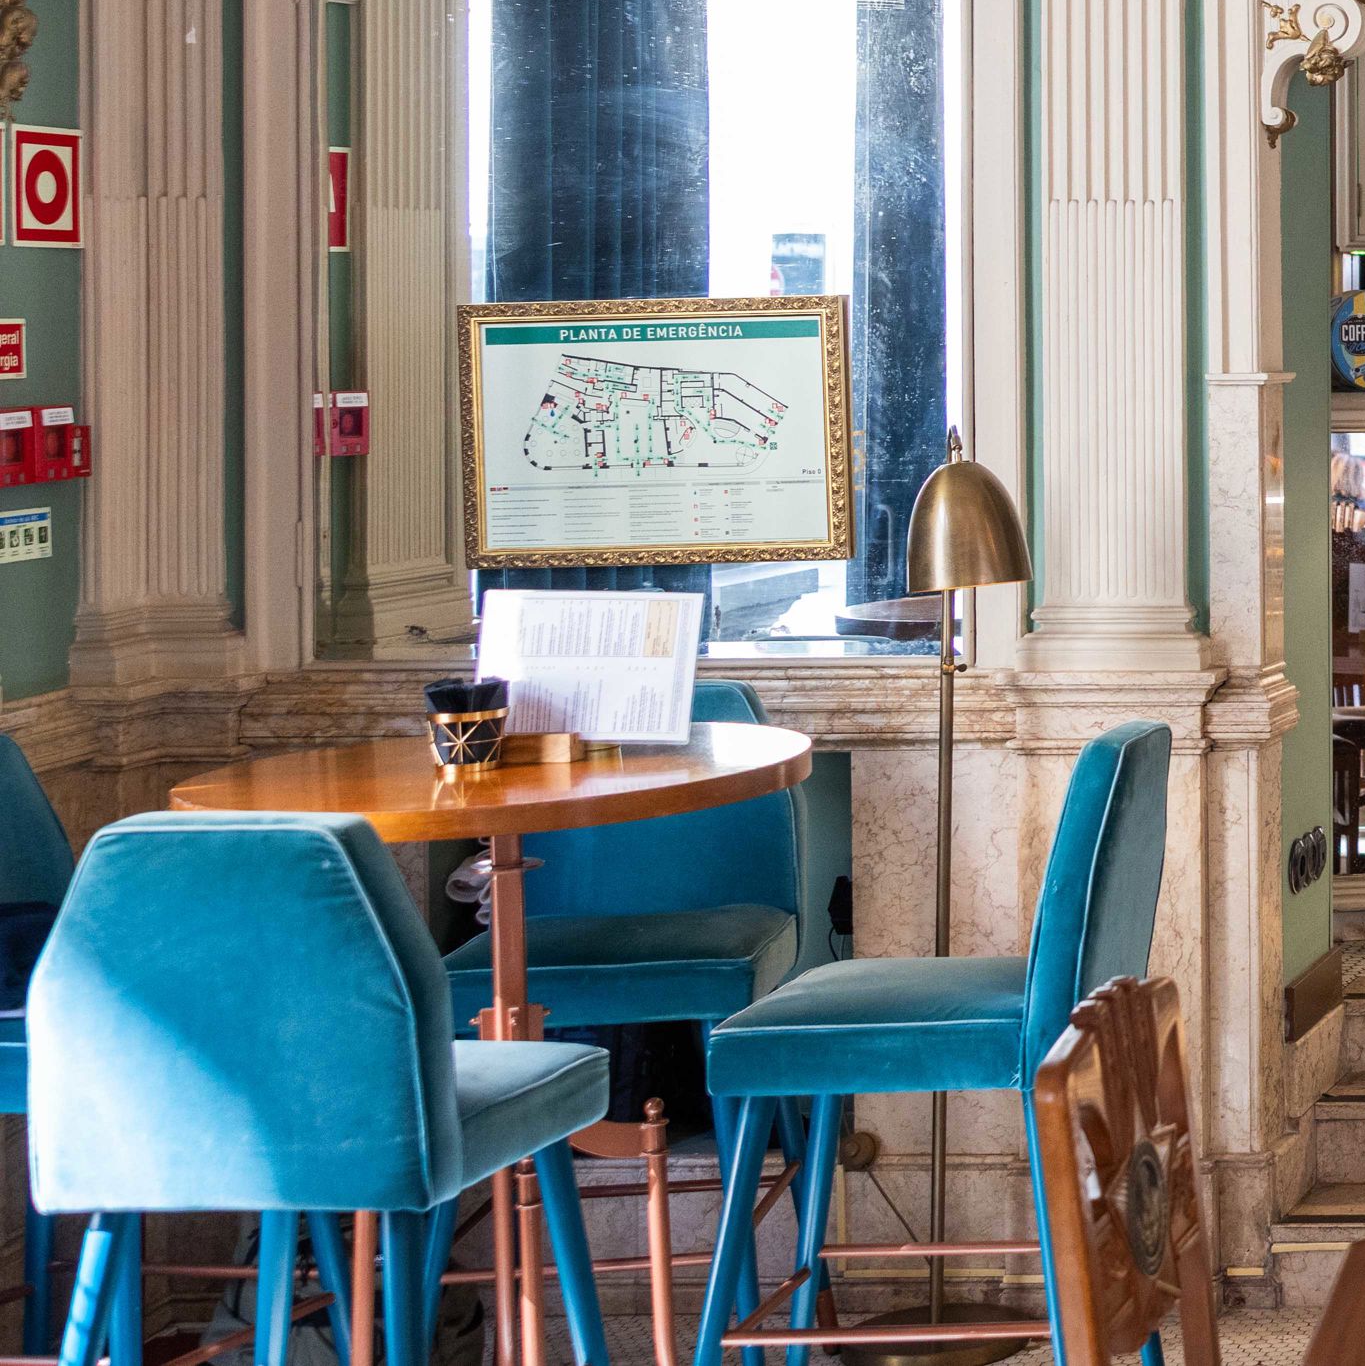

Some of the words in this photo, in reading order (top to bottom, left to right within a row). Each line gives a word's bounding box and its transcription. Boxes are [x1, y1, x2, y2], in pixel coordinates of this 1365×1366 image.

[560, 328, 618, 341] PLANTA
[622, 327, 641, 340] DE
[647, 324, 743, 339] EMERGÊNCIA
